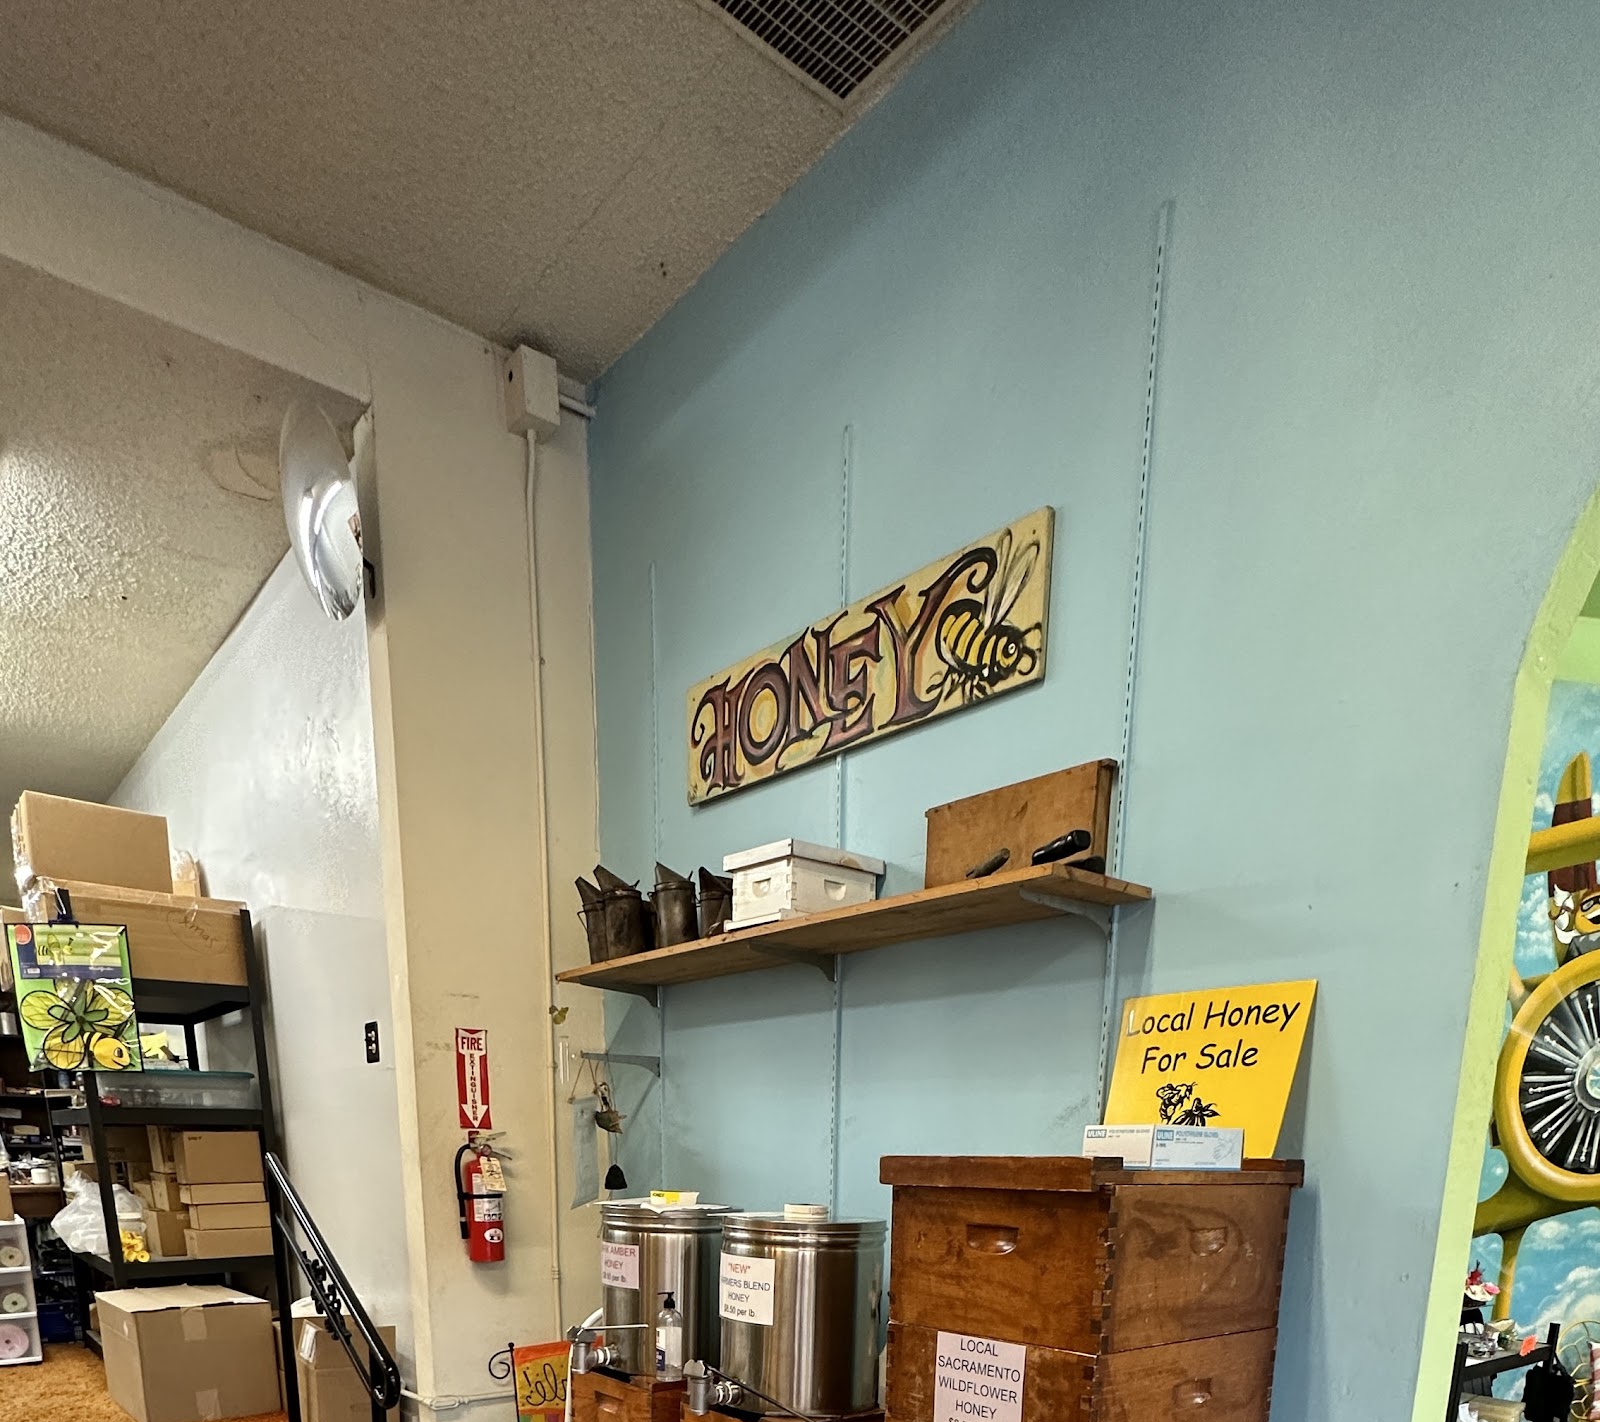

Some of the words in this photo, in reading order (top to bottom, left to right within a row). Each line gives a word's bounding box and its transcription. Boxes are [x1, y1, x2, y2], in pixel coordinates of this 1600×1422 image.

[690, 546, 998, 797] HONEY
[1126, 1002, 1195, 1037] Local
[1203, 999, 1301, 1032] Honey
[461, 1036, 483, 1051] FIRE
[1140, 1046, 1187, 1075] For
[1195, 1039, 1259, 1070] Sale
[469, 1053, 479, 1121] EXTINGUISHER
[610, 1246, 636, 1258] AMBER
[743, 1280, 771, 1291] BLEND
[727, 1291, 750, 1303] HONEY
[737, 1307, 747, 1317] per
[960, 1338, 999, 1357] LOCAL
[938, 1355, 1021, 1383] SACRAMENTO
[938, 1375, 1018, 1404] WILDFLOWER
[955, 1399, 998, 1420] HONEY
